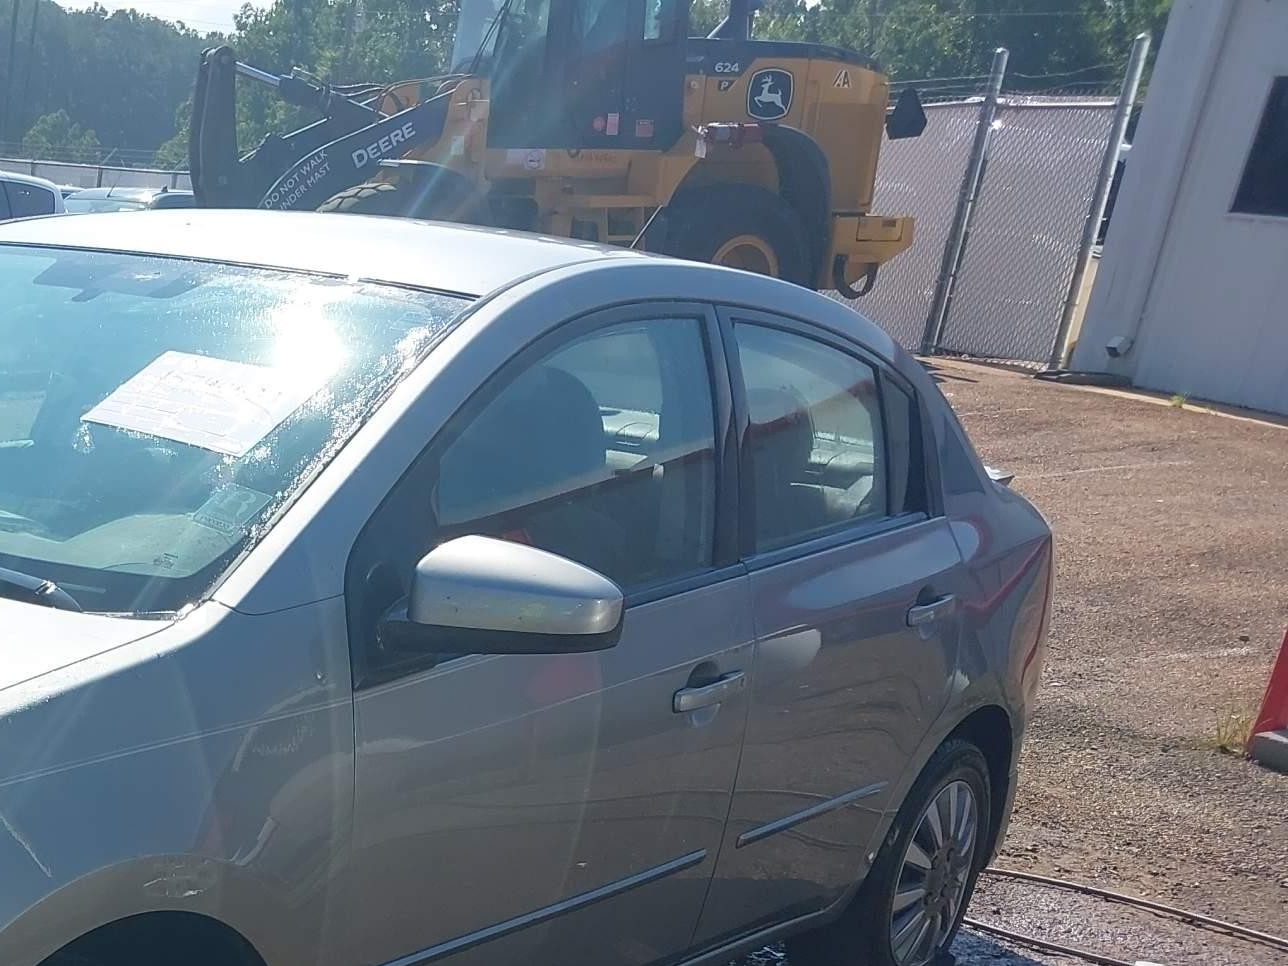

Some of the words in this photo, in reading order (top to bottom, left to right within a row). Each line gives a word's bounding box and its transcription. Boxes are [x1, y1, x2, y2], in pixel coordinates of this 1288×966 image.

[714, 62, 740, 73] 624
[720, 80, 730, 91] P
[351, 122, 416, 168] DEERE
[264, 192, 280, 209] DO
[279, 173, 302, 193] NOT
[300, 149, 328, 176] WALK
[309, 163, 332, 187] MAST
